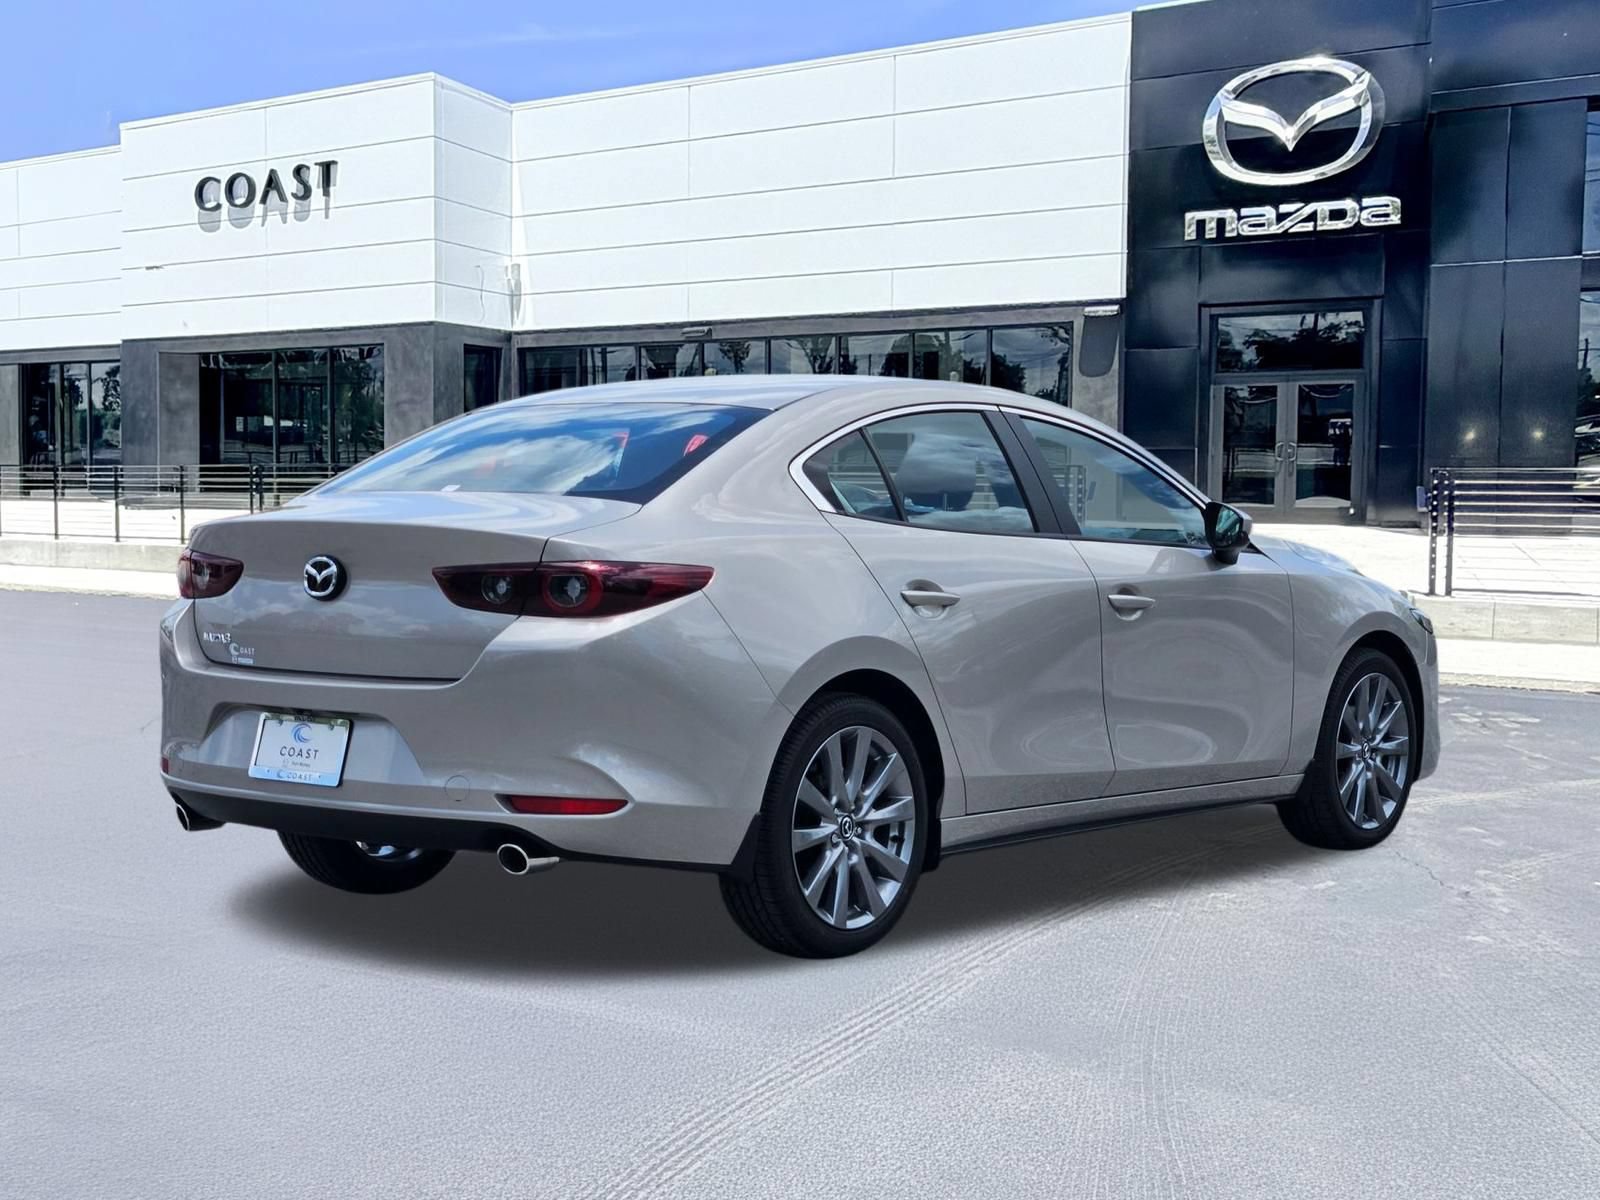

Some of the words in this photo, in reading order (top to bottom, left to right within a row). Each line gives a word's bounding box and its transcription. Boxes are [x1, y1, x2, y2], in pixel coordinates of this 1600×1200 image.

[194, 160, 338, 212] COAST
[280, 745, 319, 760] COAST
[287, 771, 312, 781] COAST
